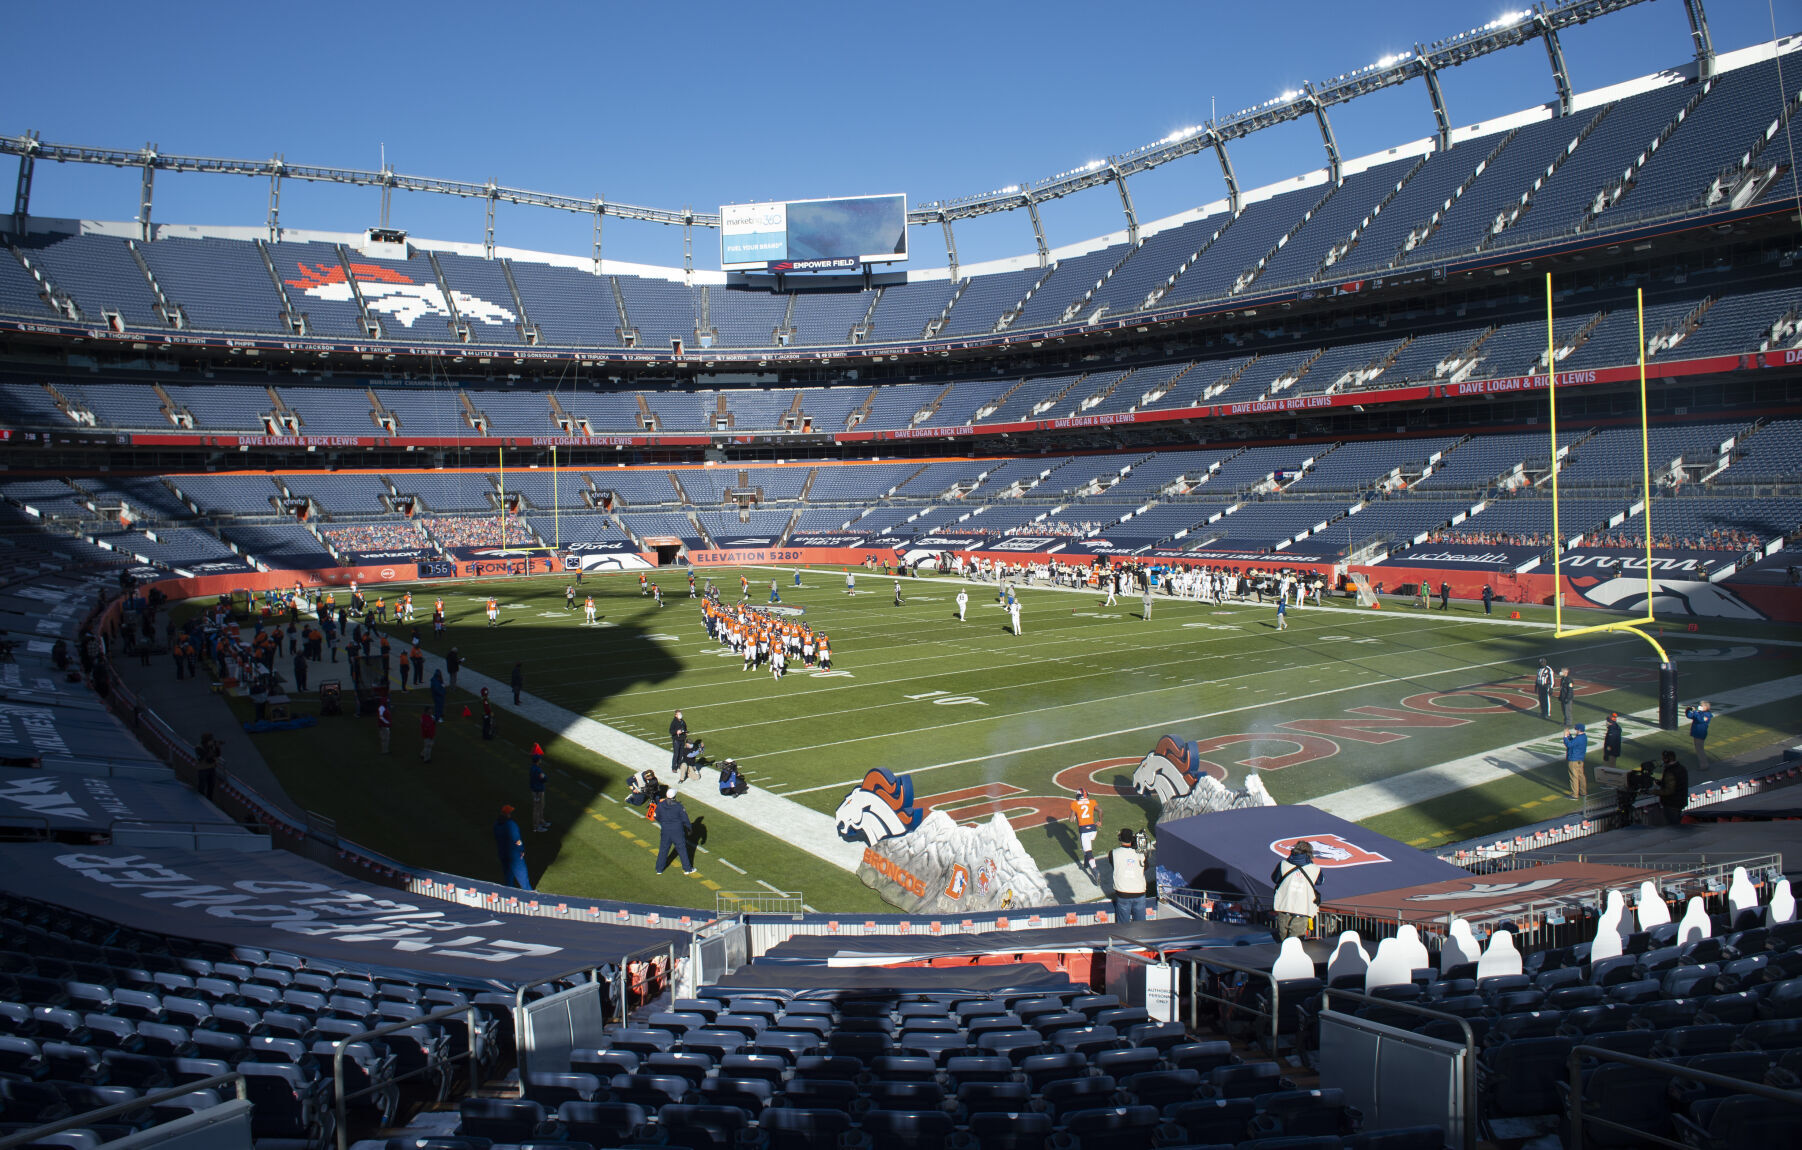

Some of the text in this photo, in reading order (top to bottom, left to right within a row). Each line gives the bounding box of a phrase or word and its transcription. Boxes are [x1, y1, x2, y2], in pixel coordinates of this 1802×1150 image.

[793, 259, 854, 270] EMPOWER FIELD
[37, 325, 60, 333] MOSES
[108, 332, 145, 341] THOMPSON
[304, 343, 335, 351] JACKSON
[383, 379, 402, 387] LIGHT
[1459, 382, 1484, 394] DAVE
[1487, 379, 1520, 392] LOGAN
[1523, 377, 1531, 388] &
[1562, 371, 1596, 385] LEWIS
[1232, 396, 1332, 414] DAVE LOGAN & RICK LEWIS
[1054, 413, 1135, 428] DAVE LOGAN & RICK LEWIS
[895, 426, 974, 438] DAVE LOGAN & RICK LEWIS
[238, 436, 358, 446] DAVE LOGAN & RICK LEWIS
[532, 437, 632, 446] DAVE LOGAN & RICK LEWIS
[591, 491, 610, 499] xfinity
[283, 498, 306, 507] xfinity
[568, 541, 623, 551] Ford
[360, 550, 413, 559] verizon
[697, 551, 803, 563] ELEVATION 5280'
[1408, 551, 1509, 563] uchealth
[466, 561, 536, 574] BRONCOS
[567, 557, 579, 568] 25
[903, 690, 983, 706] 10
[1081, 805, 1090, 819] 2
[863, 847, 927, 897] BRONCOS
[53, 851, 564, 964] EMPOWER
